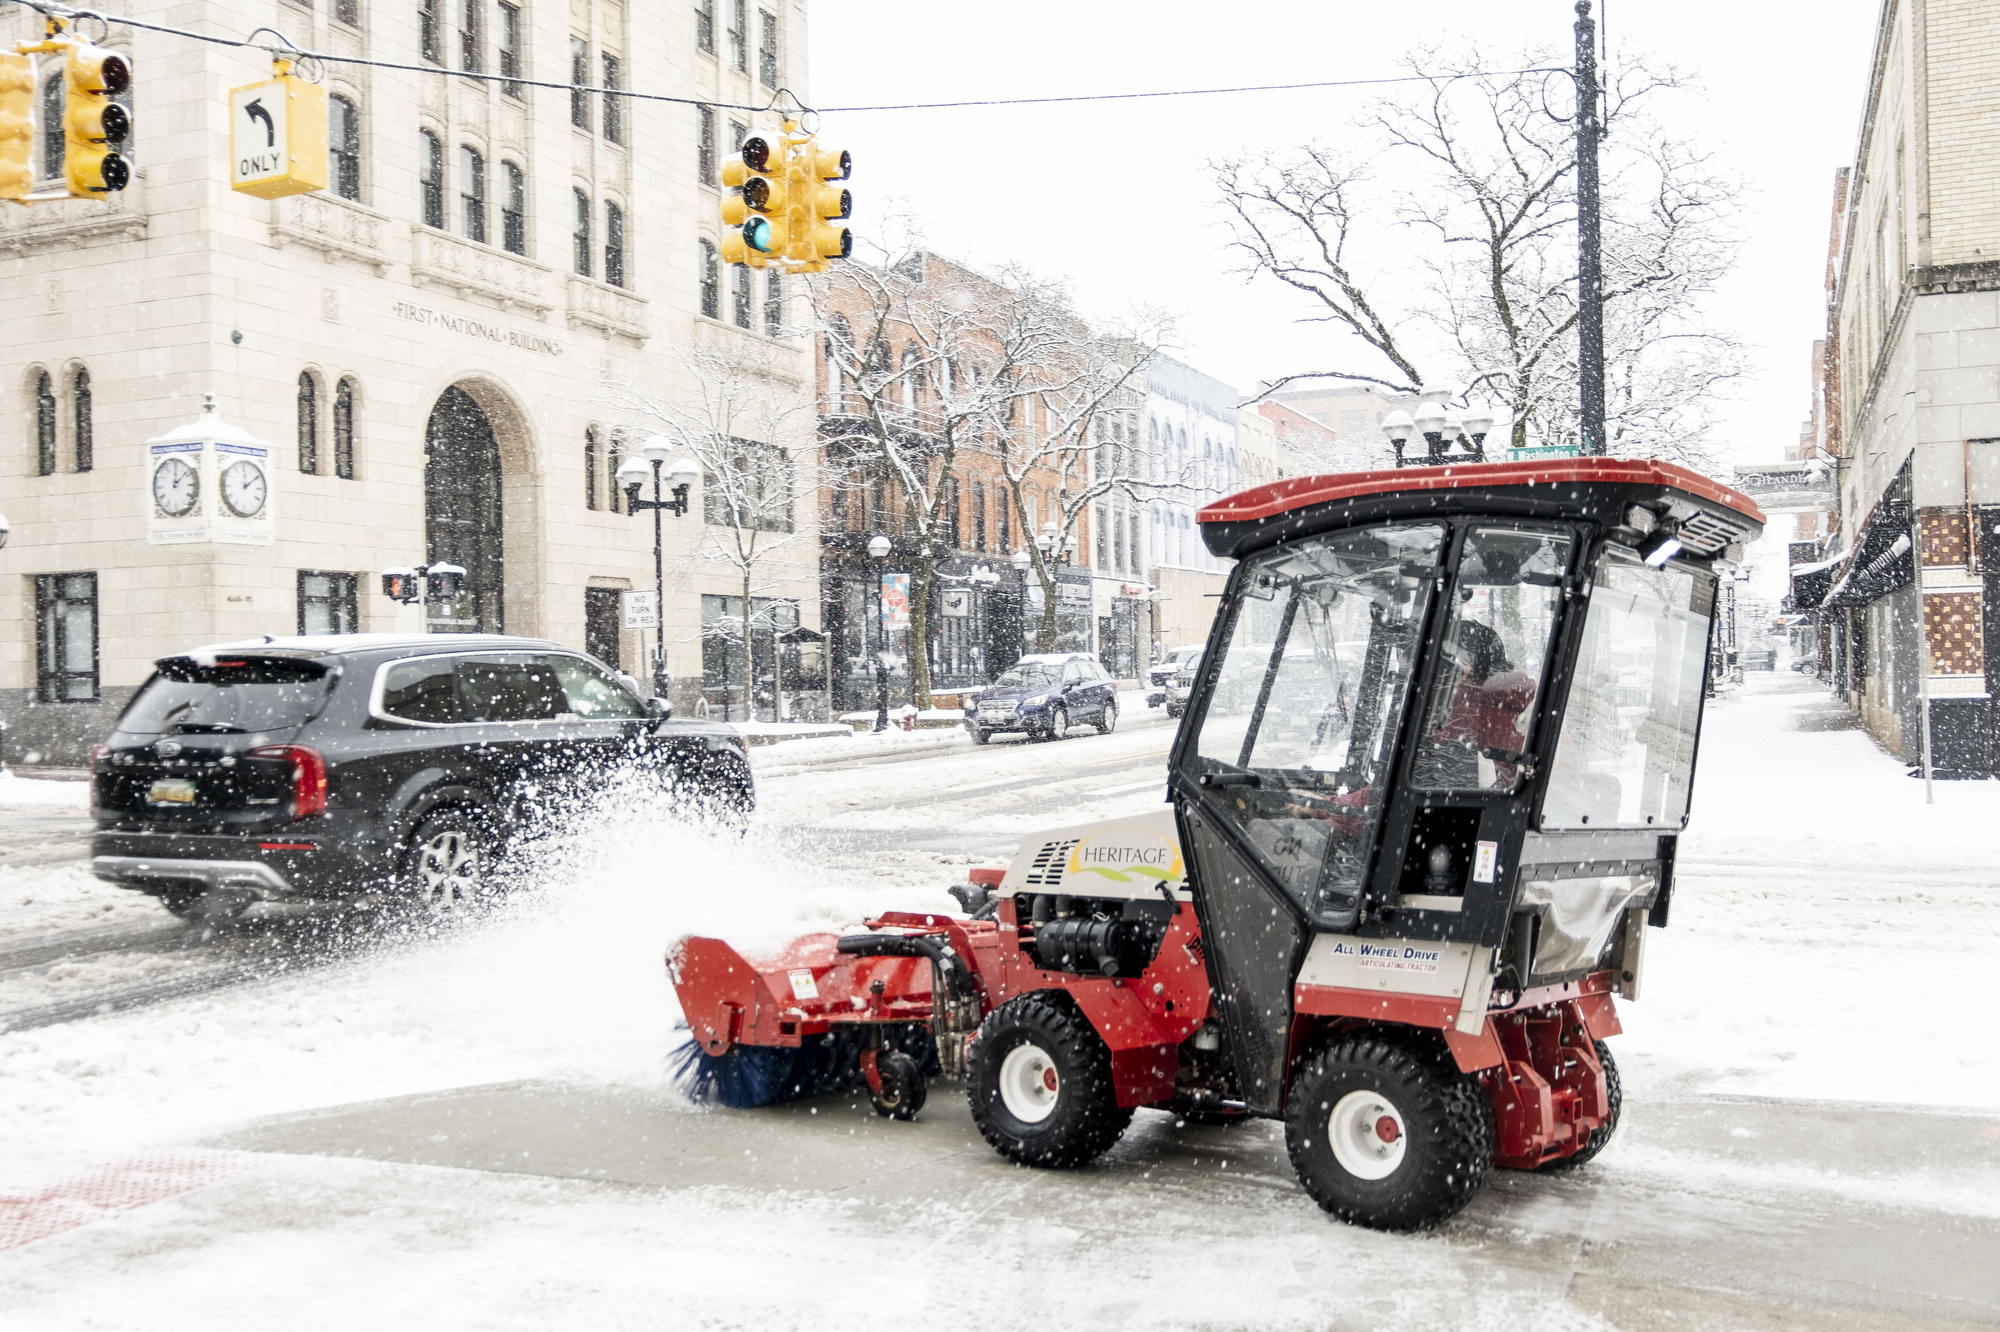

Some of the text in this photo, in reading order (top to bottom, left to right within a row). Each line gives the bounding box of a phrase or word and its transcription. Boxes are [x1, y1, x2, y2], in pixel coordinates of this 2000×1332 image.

[240, 152, 280, 176] ONLY
[397, 302, 559, 356] FIRST NATIONAL BUILDING
[1518, 447, 1570, 460] Washington
[634, 595, 646, 603] NO
[631, 606, 650, 614] TURN
[1084, 847, 1167, 864] HERITAGE
[1404, 948, 1439, 961] DRIVE
[1360, 959, 1437, 972] ARTICULATING TRACTOR
